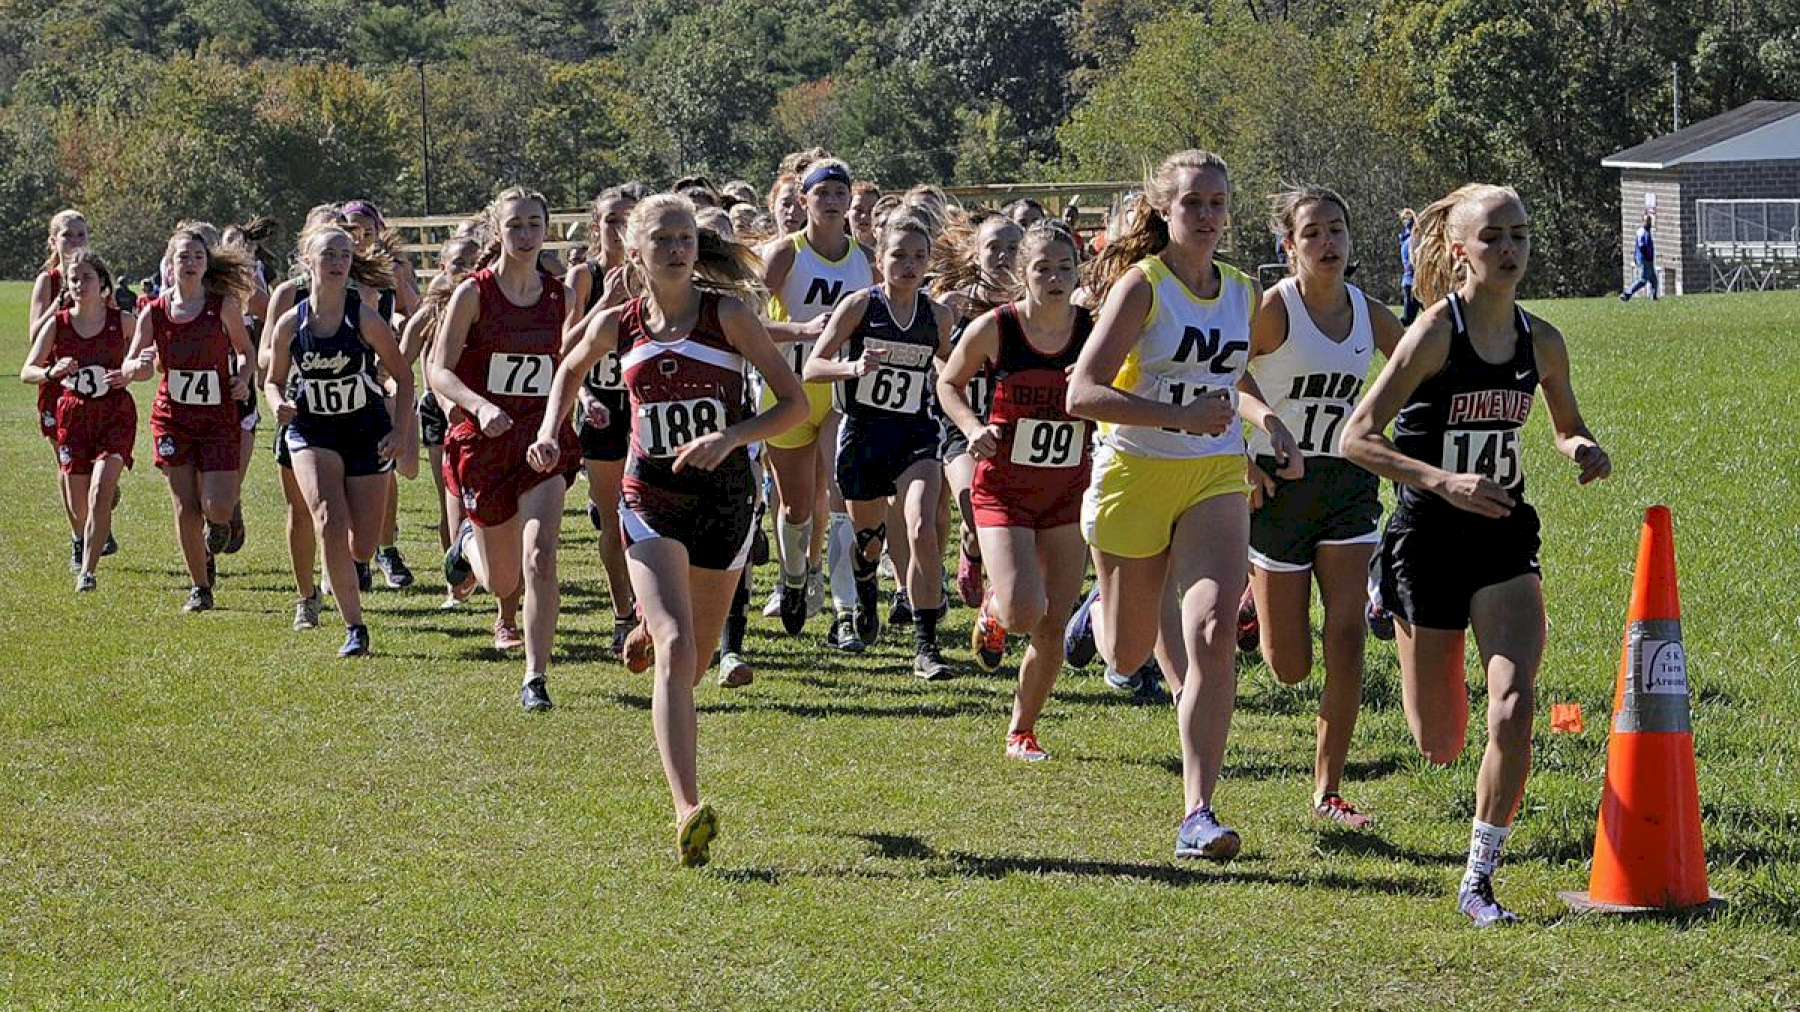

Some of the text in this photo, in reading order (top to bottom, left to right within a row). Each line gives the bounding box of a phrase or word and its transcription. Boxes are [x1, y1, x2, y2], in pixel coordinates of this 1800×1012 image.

[1173, 325, 1249, 374] NC
[70, 369, 98, 396] 73
[179, 372, 211, 402] 74
[310, 376, 358, 412] 167
[503, 356, 542, 393] 72
[871, 368, 912, 409] 63
[644, 400, 718, 455] 188
[1028, 422, 1075, 464] 99
[1453, 431, 1518, 488] 145
[1661, 664, 1681, 673] Turn
